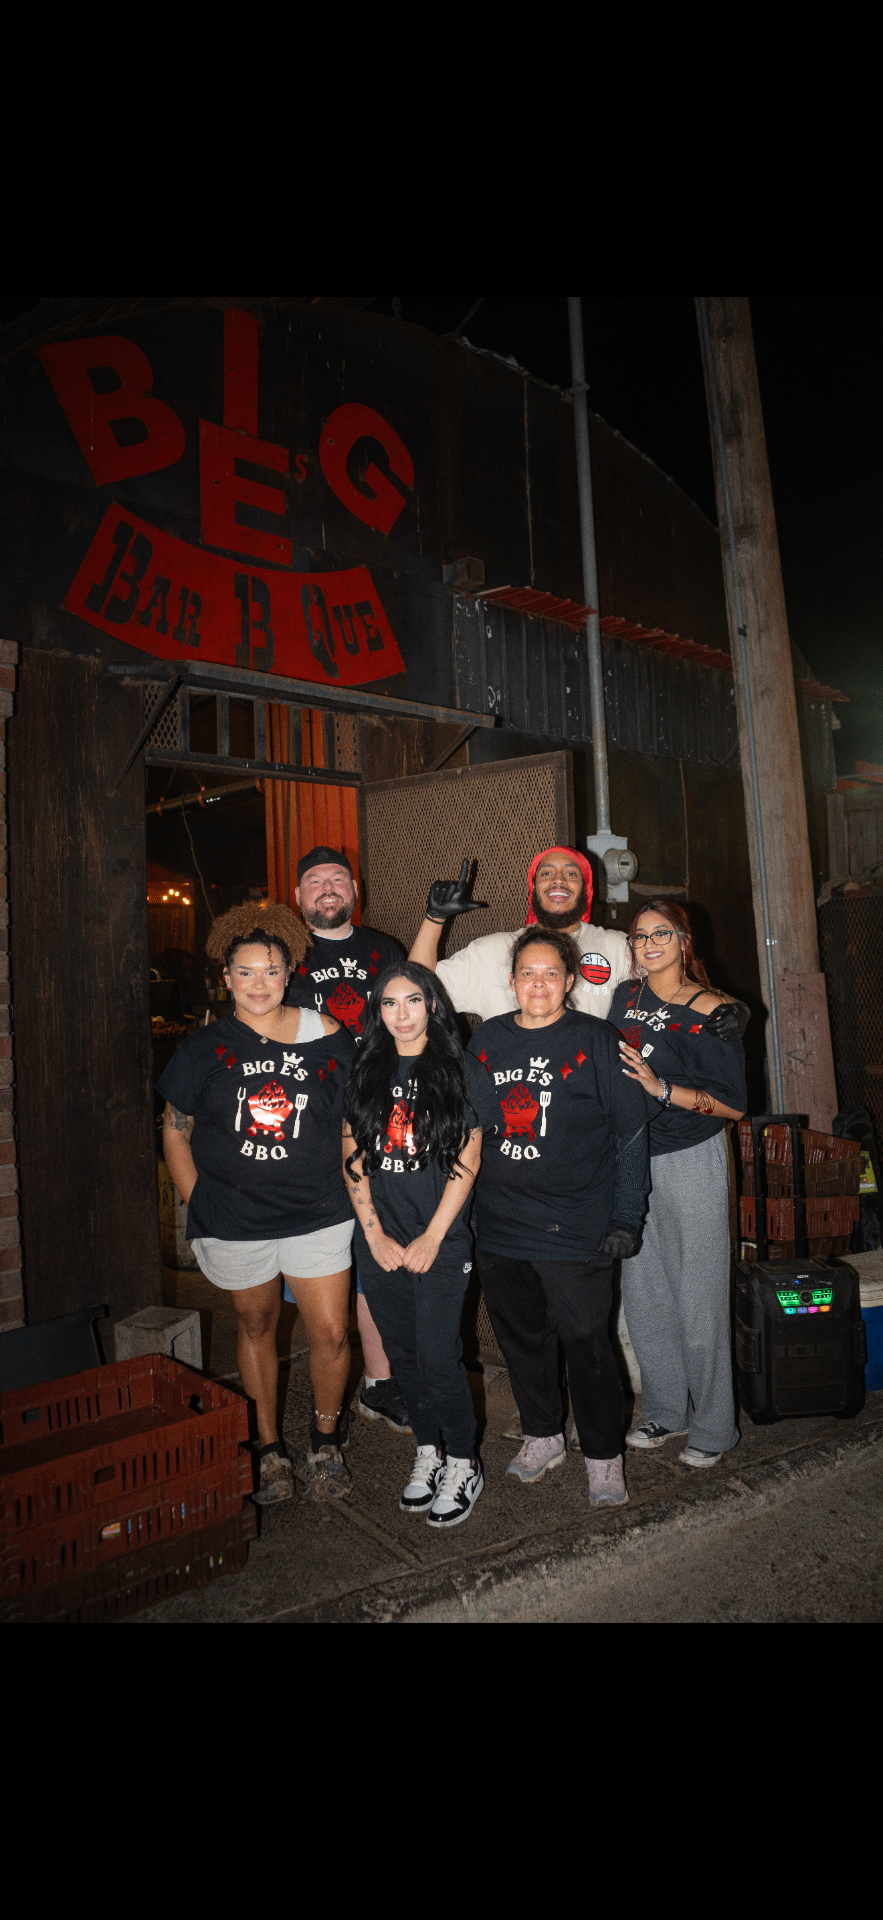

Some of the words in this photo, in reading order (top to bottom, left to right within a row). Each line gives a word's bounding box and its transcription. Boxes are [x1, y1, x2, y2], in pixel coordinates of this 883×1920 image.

[38, 308, 415, 536] BIG
[233, 571, 276, 674] B
[580, 953, 610, 968] BIG
[310, 966, 340, 984] BIG
[343, 964, 368, 981] E'S
[582, 983, 608, 996] BBQ
[623, 1009, 649, 1022] BIG
[645, 1015, 666, 1032] E'S
[241, 1060, 275, 1077] BIG
[279, 1062, 309, 1082] E'S
[493, 1068, 523, 1086] BIG
[526, 1067, 554, 1087] E'S
[239, 1139, 289, 1161] BBQ
[500, 1138, 541, 1161] BBQ
